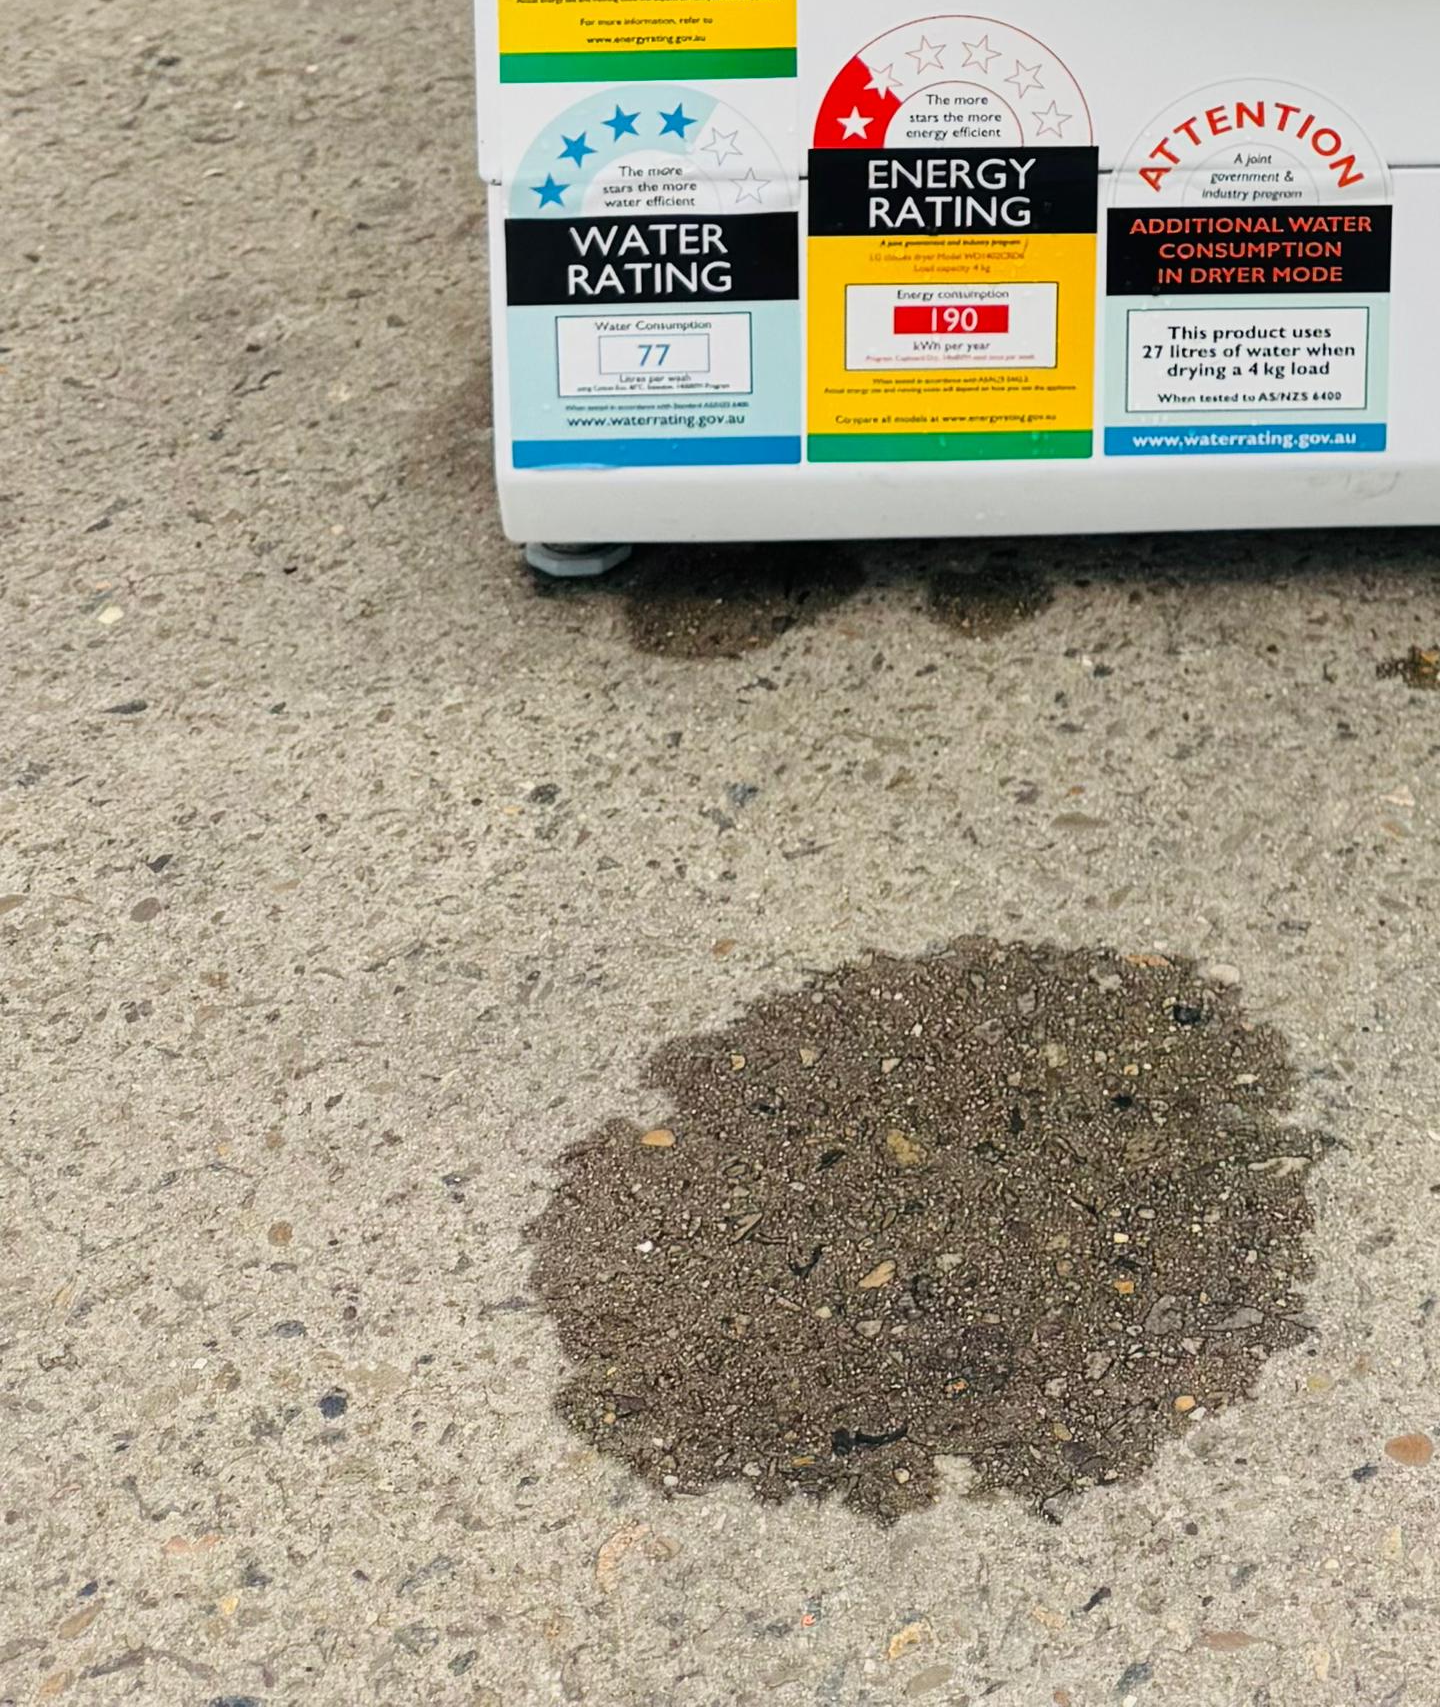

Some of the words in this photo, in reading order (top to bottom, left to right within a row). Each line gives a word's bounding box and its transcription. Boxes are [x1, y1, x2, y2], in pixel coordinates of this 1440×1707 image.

[926, 95, 951, 106] The
[954, 96, 989, 106] more
[909, 113, 940, 123] stars
[944, 112, 964, 122] the
[968, 113, 1002, 123] more
[906, 128, 948, 140] energy
[952, 127, 1001, 138] efficient
[1139, 100, 1364, 193] ATTENTION
[1234, 154, 1243, 164] A
[1245, 153, 1272, 167] joint
[618, 166, 643, 178] The
[648, 166, 683, 177] more
[868, 158, 1036, 190] ENERGY
[1210, 171, 1279, 184] government
[1284, 170, 1294, 182] &
[603, 182, 633, 194] stars
[638, 181, 658, 193] the
[662, 181, 697, 191] more
[1202, 188, 1249, 200] industry
[1252, 189, 1302, 201] program
[604, 197, 642, 208] water
[646, 195, 695, 207] efficient
[870, 196, 1031, 228] RATING
[1129, 218, 1283, 235] ADDITIONAL
[1288, 216, 1372, 233] WATER
[569, 224, 728, 257] WATER
[1159, 242, 1342, 259] CONSUMPTION
[567, 261, 732, 296] RATING
[1158, 269, 1182, 284] IN
[1190, 267, 1266, 283] DRYER
[1272, 267, 1343, 282] MODE
[897, 289, 933, 301] Energy
[938, 289, 1009, 300] consumption
[595, 321, 631, 332] Water
[636, 319, 712, 332] Consumption
[931, 307, 978, 333] 190
[1168, 325, 1208, 339] This
[1213, 326, 1285, 343] product
[1292, 327, 1332, 338] uses
[913, 340, 941, 351] kWh
[945, 343, 962, 352] per
[967, 342, 990, 352] year
[1142, 345, 1163, 359] 27
[1170, 345, 1216, 358] litres
[1222, 345, 1242, 358] of
[1246, 345, 1301, 357] water
[1306, 344, 1355, 357] when
[637, 343, 671, 367] 77
[1167, 364, 1226, 380] drying
[1232, 366, 1242, 376] a
[1249, 363, 1259, 376] 4
[1263, 363, 1285, 379] kg
[1291, 362, 1329, 376] load
[619, 374, 646, 383] Litres
[649, 376, 664, 384] per
[1158, 392, 1197, 403] When
[1200, 392, 1238, 403] tested
[1242, 393, 1255, 402] to
[1258, 391, 1308, 402] AS/NZS
[567, 414, 745, 428] www.waterrating.gov.au
[1132, 431, 1357, 449] www.waterrating.gov.au
